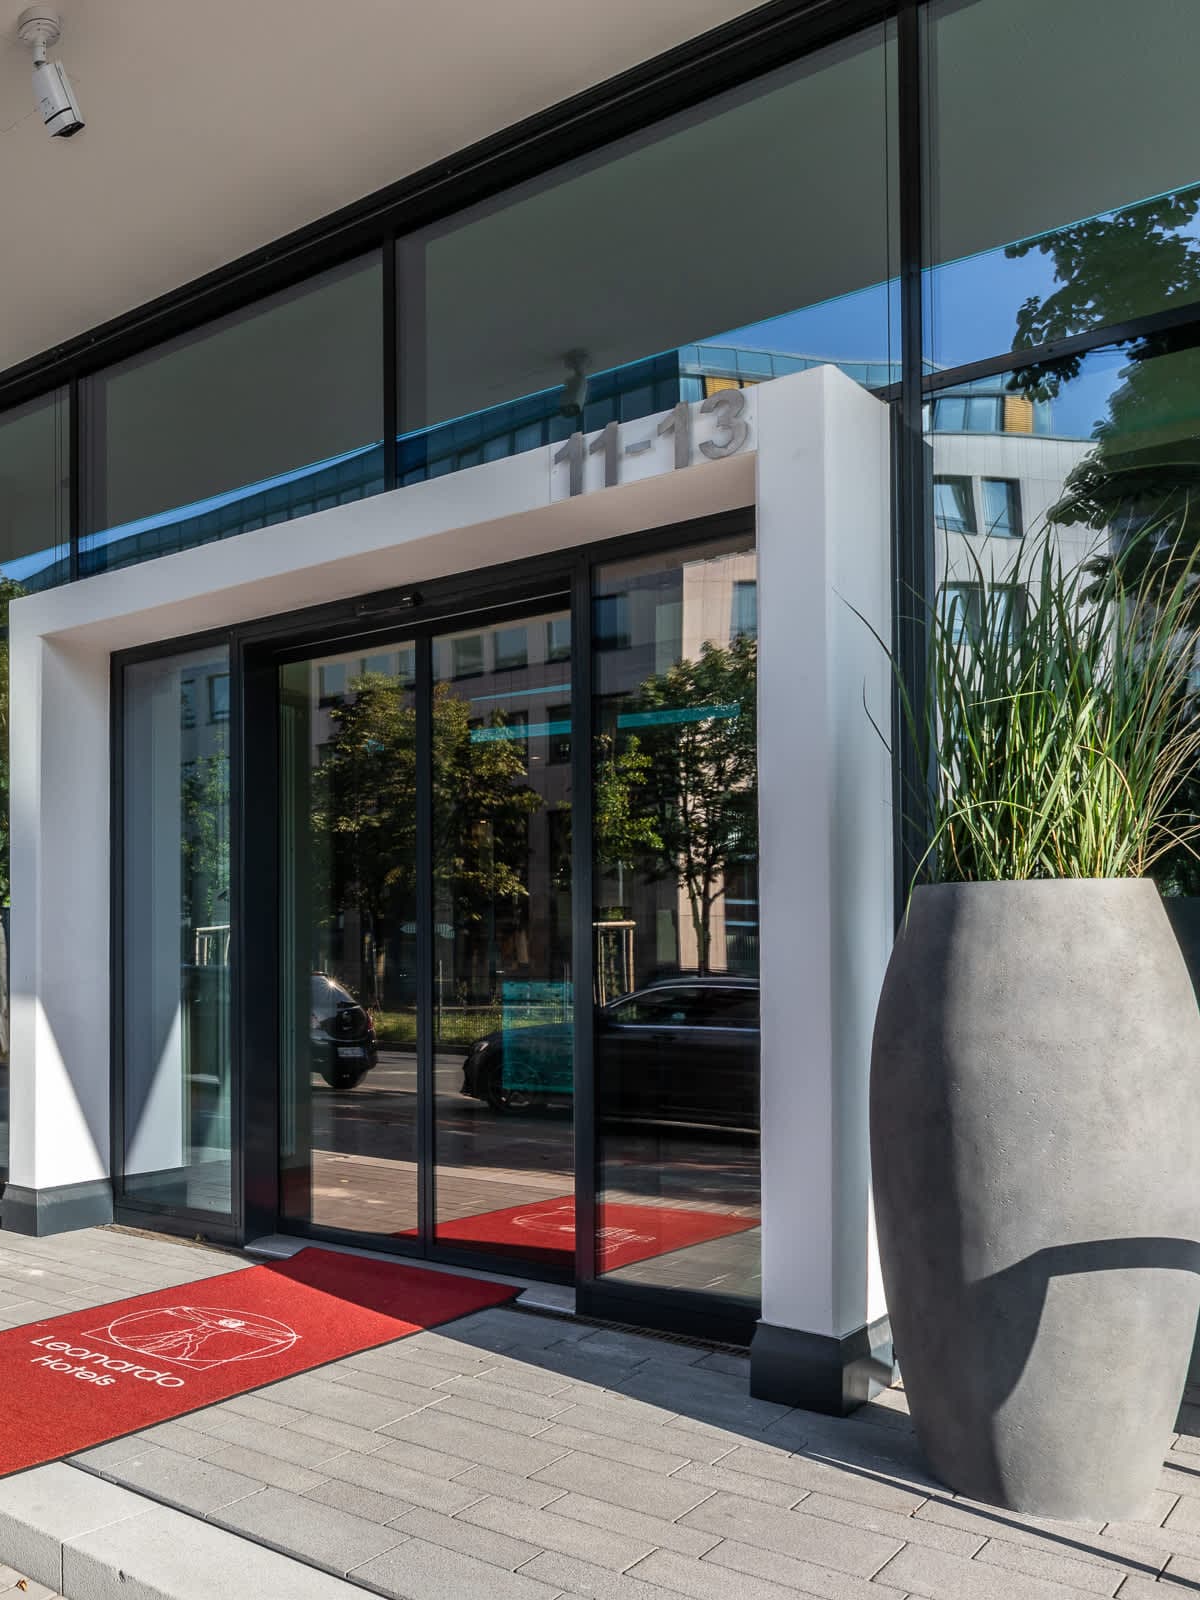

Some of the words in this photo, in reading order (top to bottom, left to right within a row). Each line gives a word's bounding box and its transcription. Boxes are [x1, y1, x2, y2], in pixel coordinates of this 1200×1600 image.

[554, 389, 749, 497] 11-13
[29, 1335, 185, 1388] Leonardo
[30, 1355, 117, 1387] Hotels
